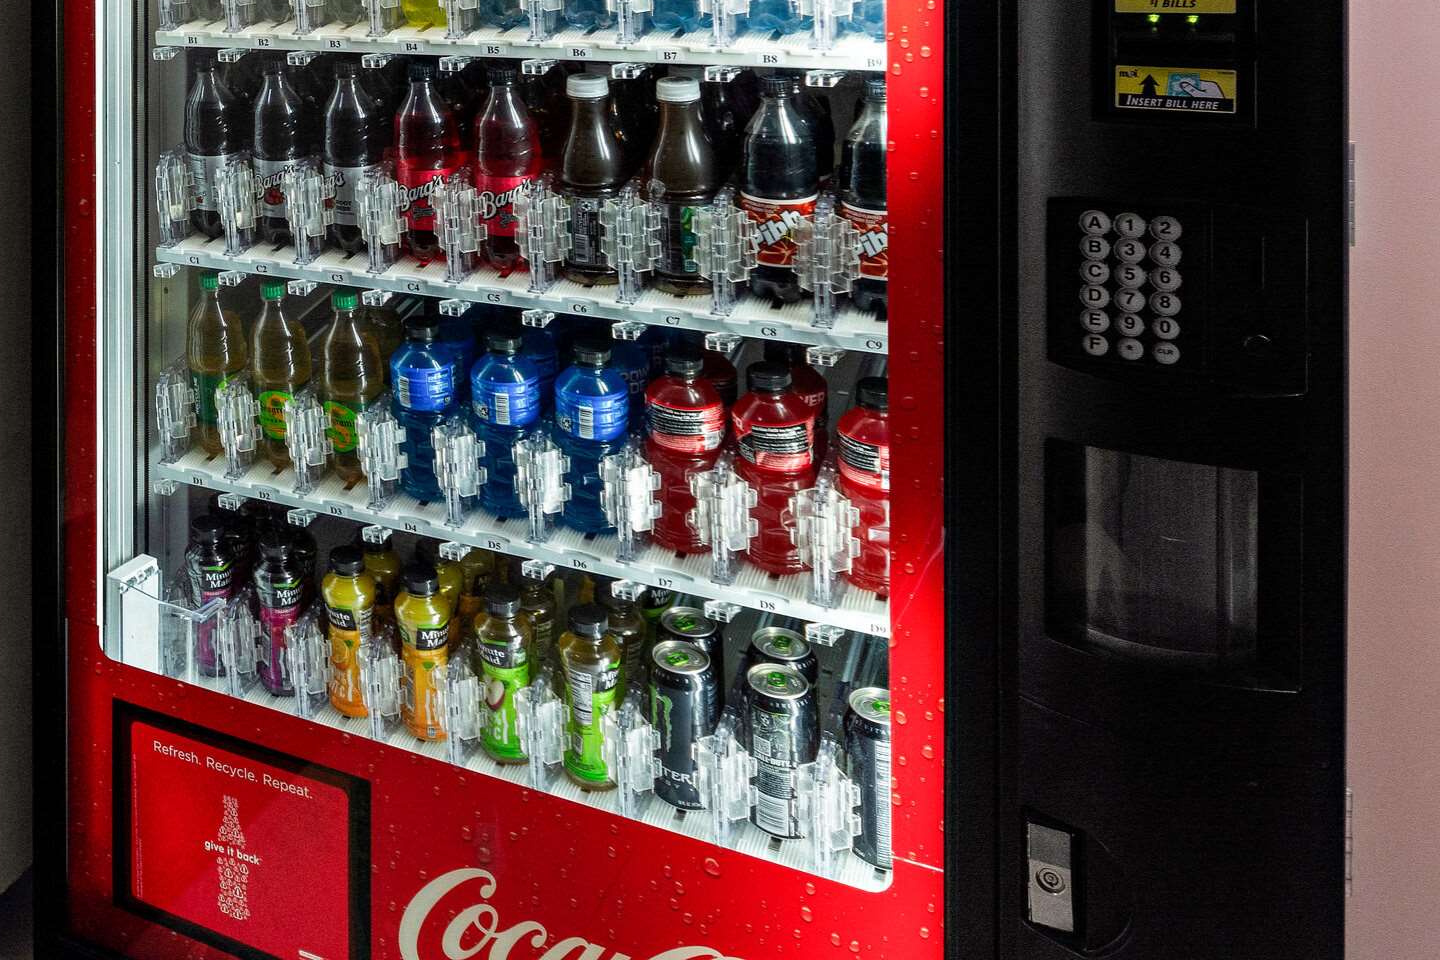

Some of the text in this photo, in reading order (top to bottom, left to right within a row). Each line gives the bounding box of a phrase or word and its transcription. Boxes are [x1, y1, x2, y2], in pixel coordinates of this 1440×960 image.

[1162, 0, 1197, 8] BILLS
[188, 36, 198, 45] B1
[258, 38, 269, 47] B2
[330, 40, 341, 49] B3
[406, 43, 418, 51] B4
[487, 46, 500, 55] B5
[572, 48, 586, 57] B6
[663, 51, 677, 60] B7
[763, 54, 778, 64] B8
[867, 58, 882, 67] B9
[1126, 95, 1220, 110] INSERT BILL HERE
[1088, 216, 1102, 229] A
[1126, 219, 1133, 231] 1
[1161, 222, 1171, 234] 2
[851, 223, 888, 262] Pib
[1090, 241, 1101, 253] B
[1125, 243, 1135, 256] 3
[1161, 246, 1171, 259] 4
[189, 256, 200, 264] C1
[256, 265, 268, 273] C2
[1089, 265, 1101, 277] C
[331, 273, 343, 282] C3
[1125, 268, 1135, 281] 5
[1161, 271, 1171, 284] 6
[407, 282, 420, 291] C4
[487, 293, 501, 302] C5
[1089, 289, 1101, 302] D
[1125, 292, 1136, 305] 7
[1161, 296, 1171, 309] 8
[573, 304, 587, 314] C6
[666, 316, 681, 325] C7
[1090, 313, 1101, 326] E
[1125, 316, 1135, 330] 9
[761, 327, 777, 337] C8
[1161, 321, 1171, 334] 0
[866, 340, 882, 350] C9
[1090, 337, 1101, 350] F
[193, 477, 203, 485] D1
[259, 492, 270, 500] D2
[330, 506, 342, 515] D3
[488, 541, 501, 550] D5
[573, 559, 587, 569] D6
[760, 600, 776, 611] D8
[153, 740, 313, 799] Refresh. Recycle. Repeat.
[204, 840, 261, 866] give it back
